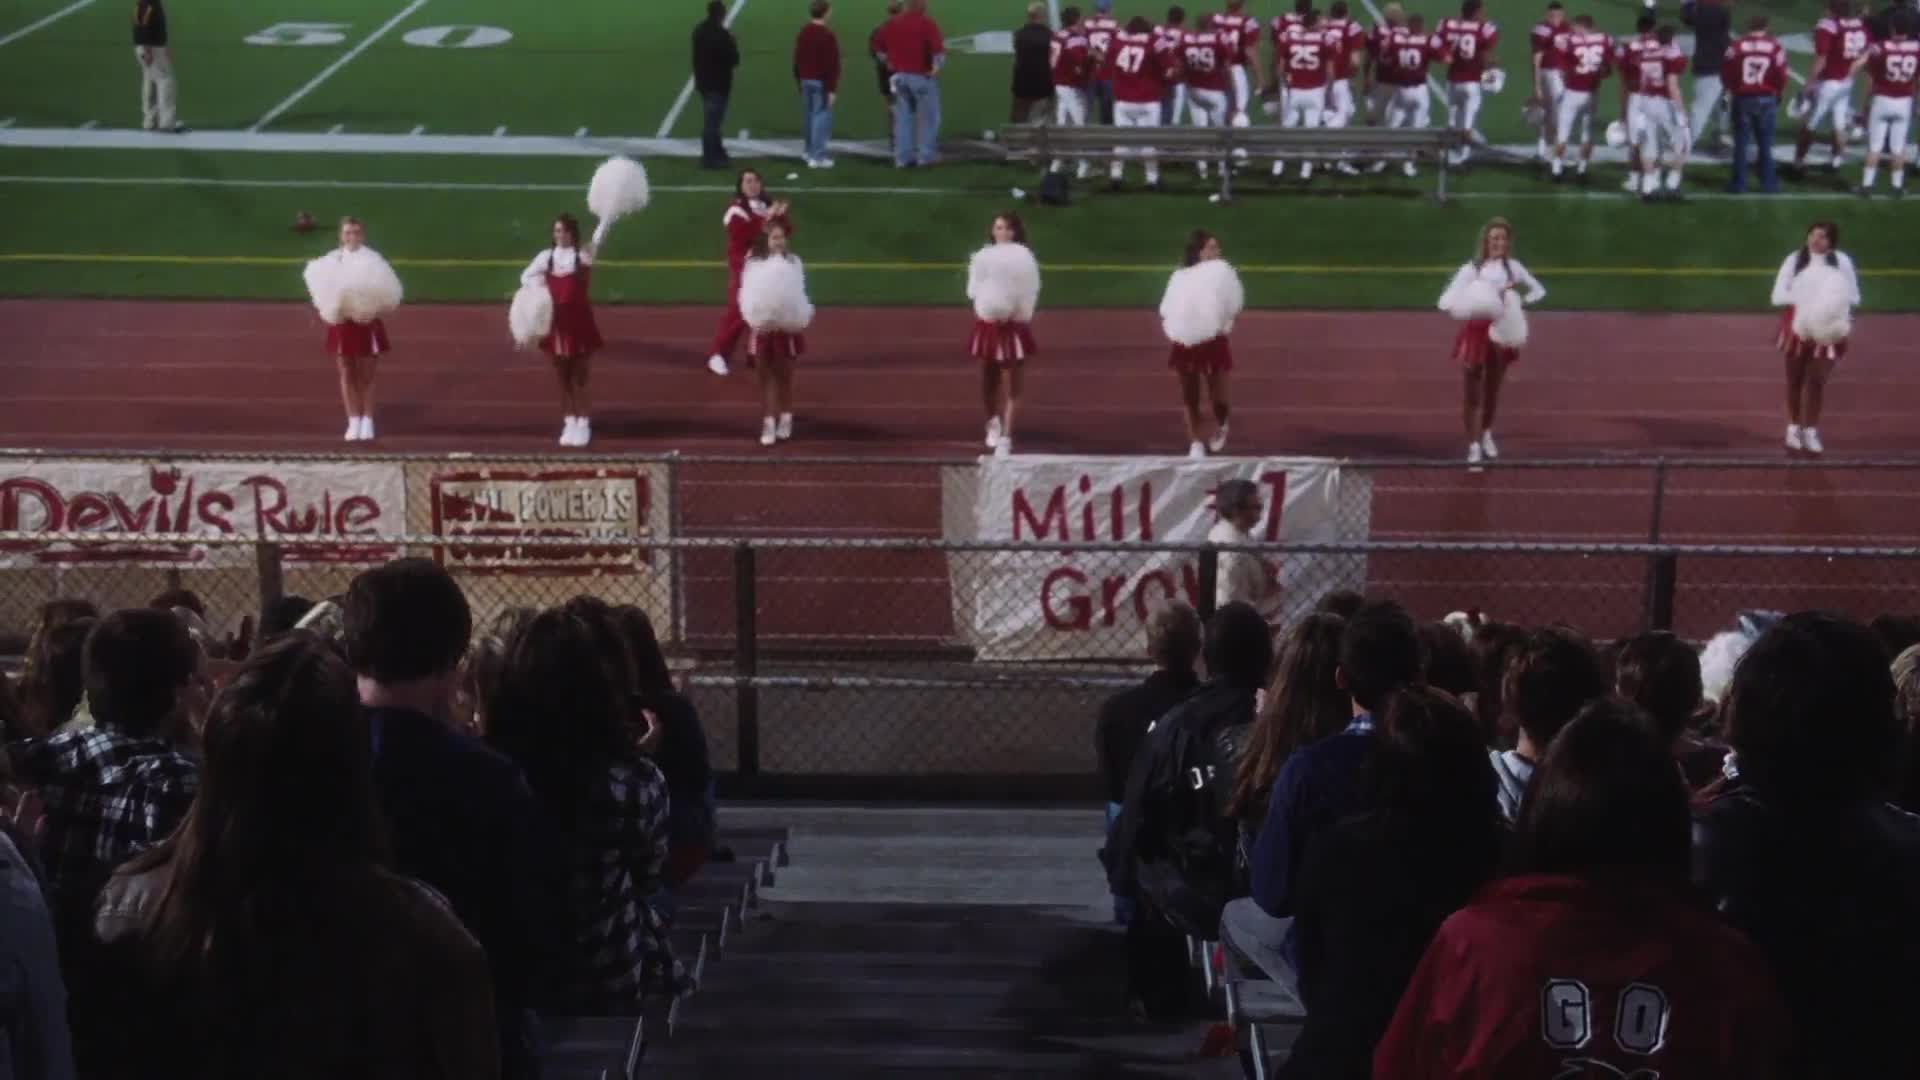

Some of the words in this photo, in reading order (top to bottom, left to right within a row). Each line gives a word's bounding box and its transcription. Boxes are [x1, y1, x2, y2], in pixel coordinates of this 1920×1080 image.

[1115, 45, 1145, 73] 47
[1289, 45, 1321, 70] 25
[0, 467, 236, 538] Devils
[240, 475, 381, 541] Rule
[518, 486, 597, 523] POWER
[600, 486, 632, 521] IS
[1011, 474, 1154, 550] Mill
[1541, 979, 1669, 1054] GO
